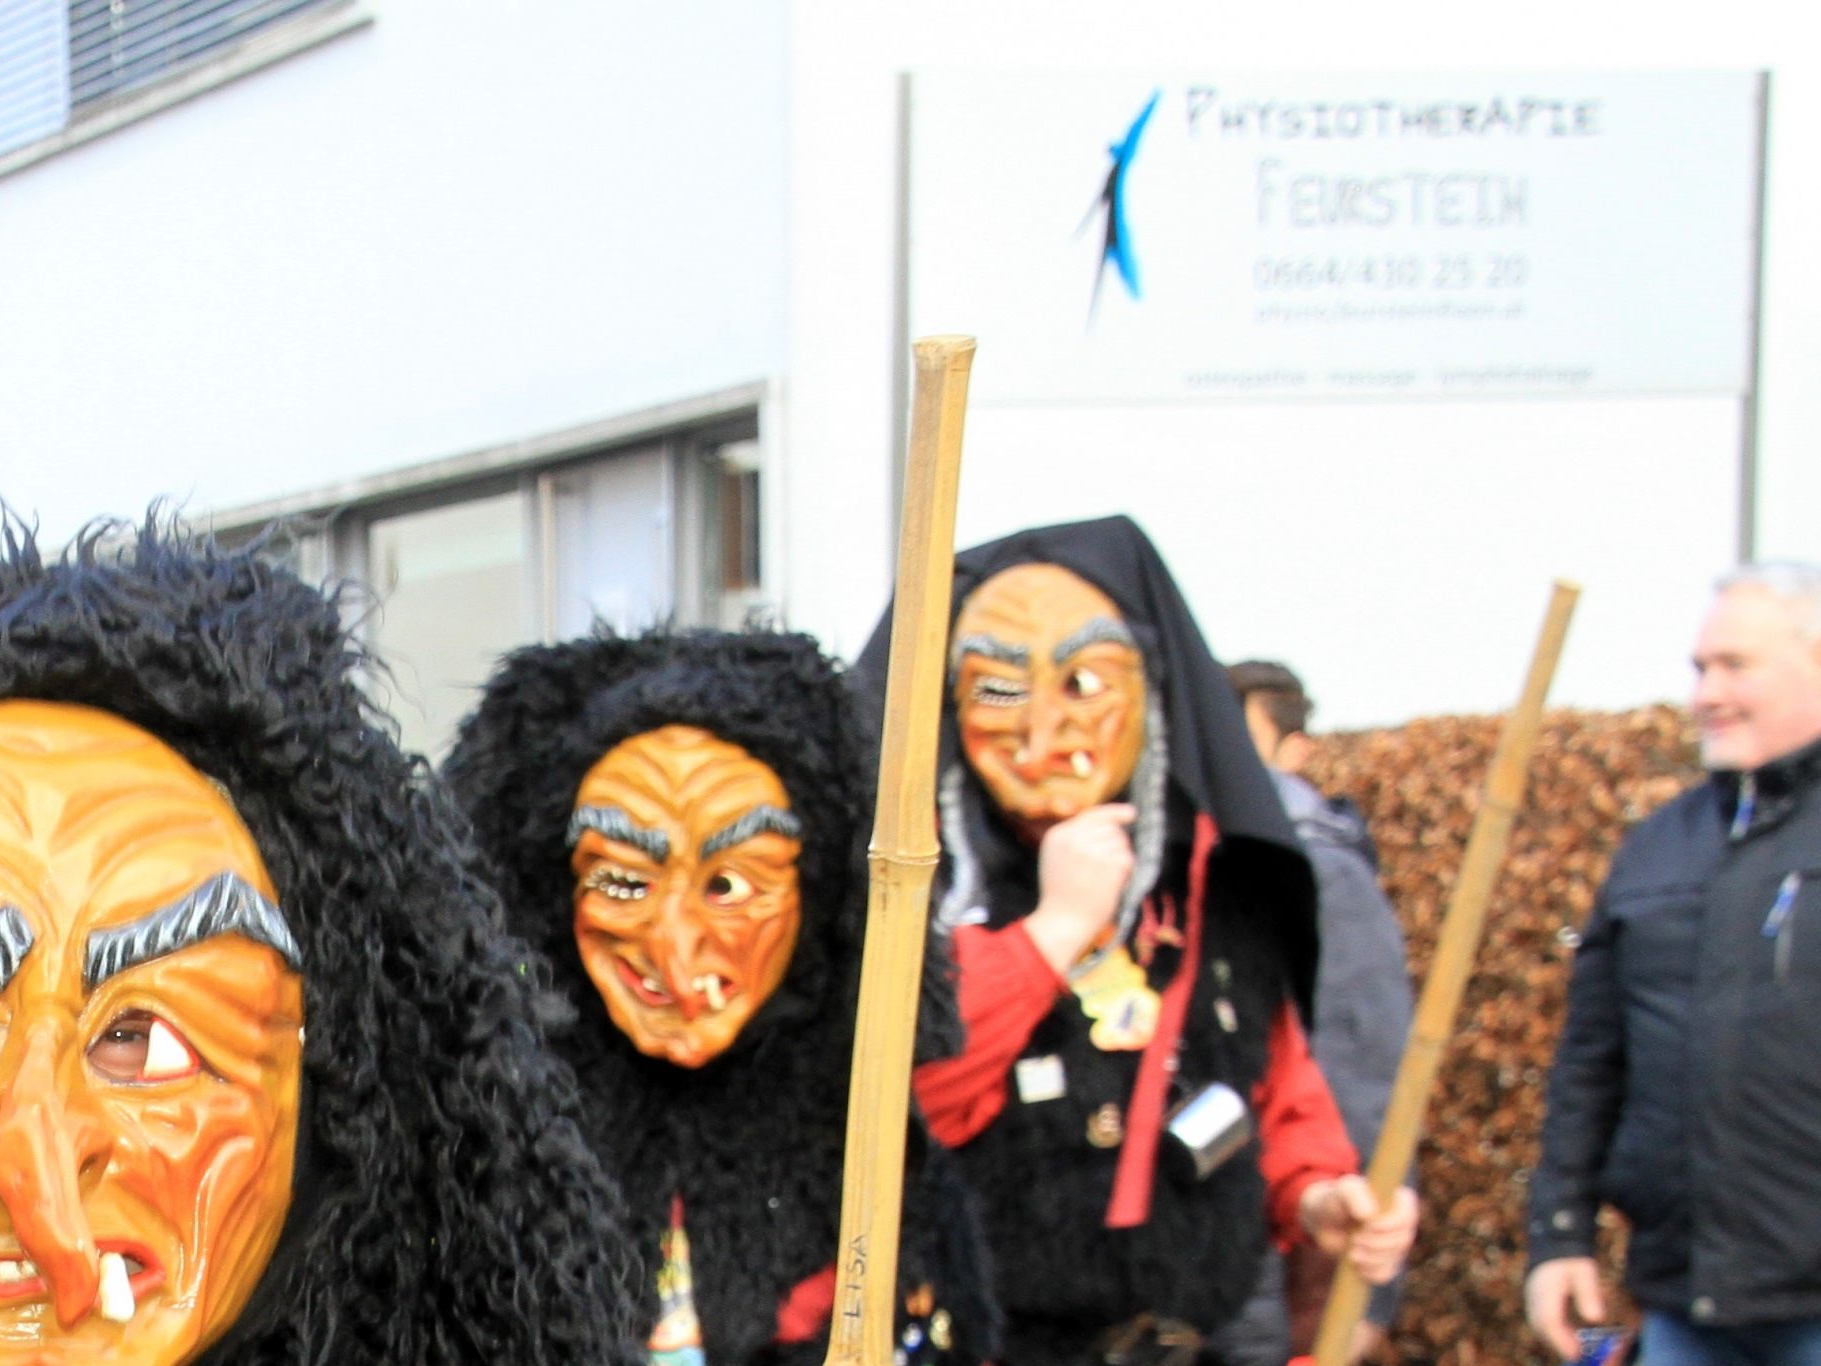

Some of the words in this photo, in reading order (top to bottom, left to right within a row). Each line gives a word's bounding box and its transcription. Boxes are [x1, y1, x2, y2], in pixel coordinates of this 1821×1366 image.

[1185, 83, 1605, 139] PHYSIOTHERAPIE
[1485, 252, 1531, 289] 20
[843, 1234, 868, 1319] LISA
